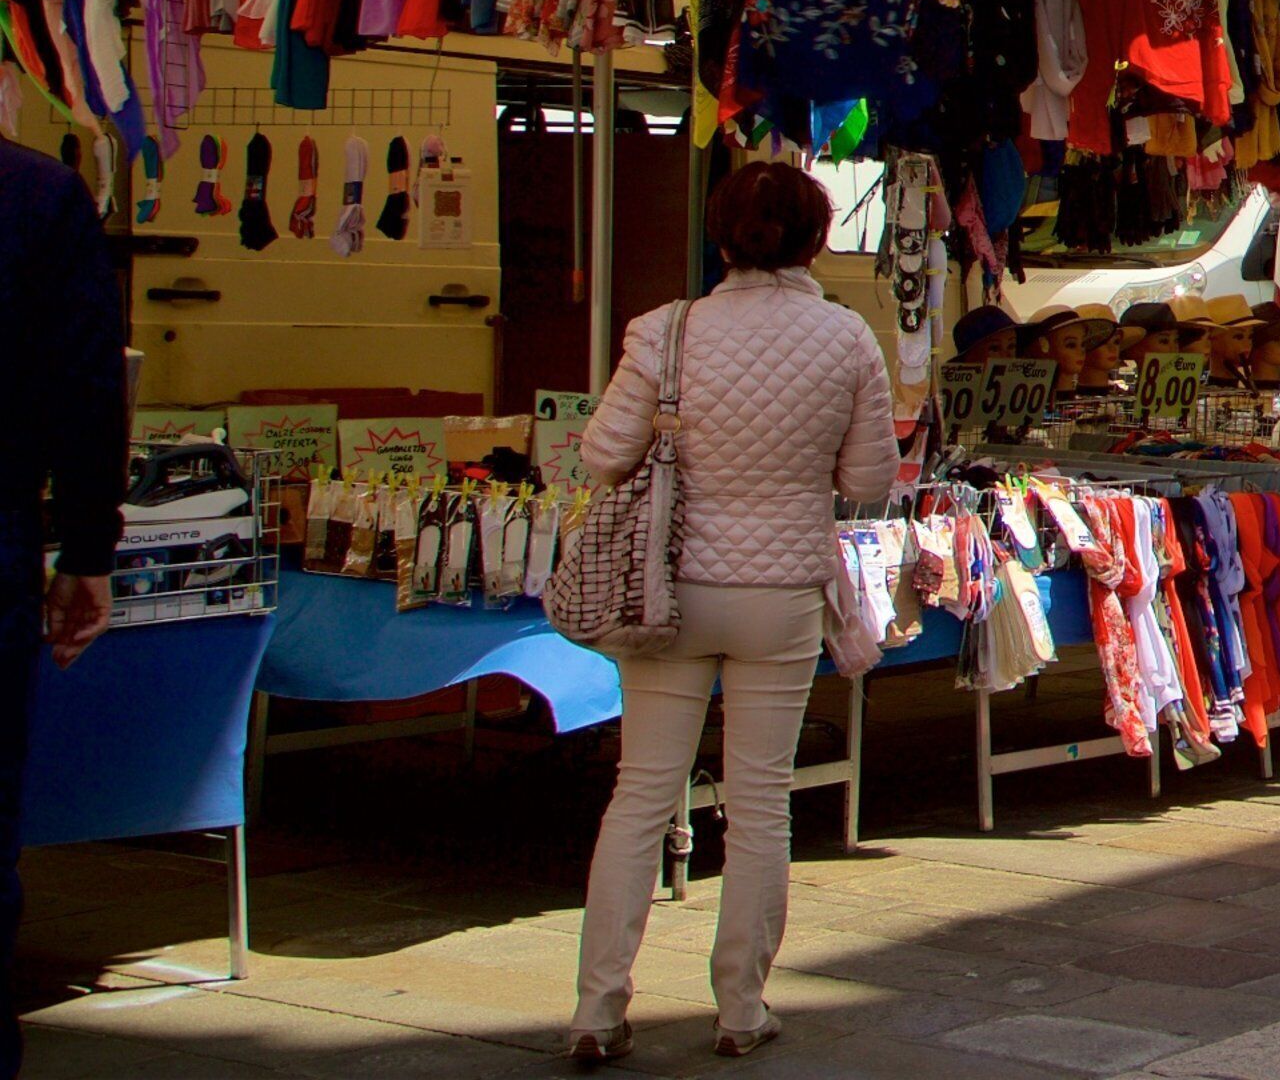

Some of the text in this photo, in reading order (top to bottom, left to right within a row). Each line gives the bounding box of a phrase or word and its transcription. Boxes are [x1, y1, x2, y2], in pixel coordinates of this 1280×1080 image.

[981, 364, 1046, 420] 5,00
[1140, 358, 1197, 413] 8,00
[273, 438, 319, 449] OFFERTA
